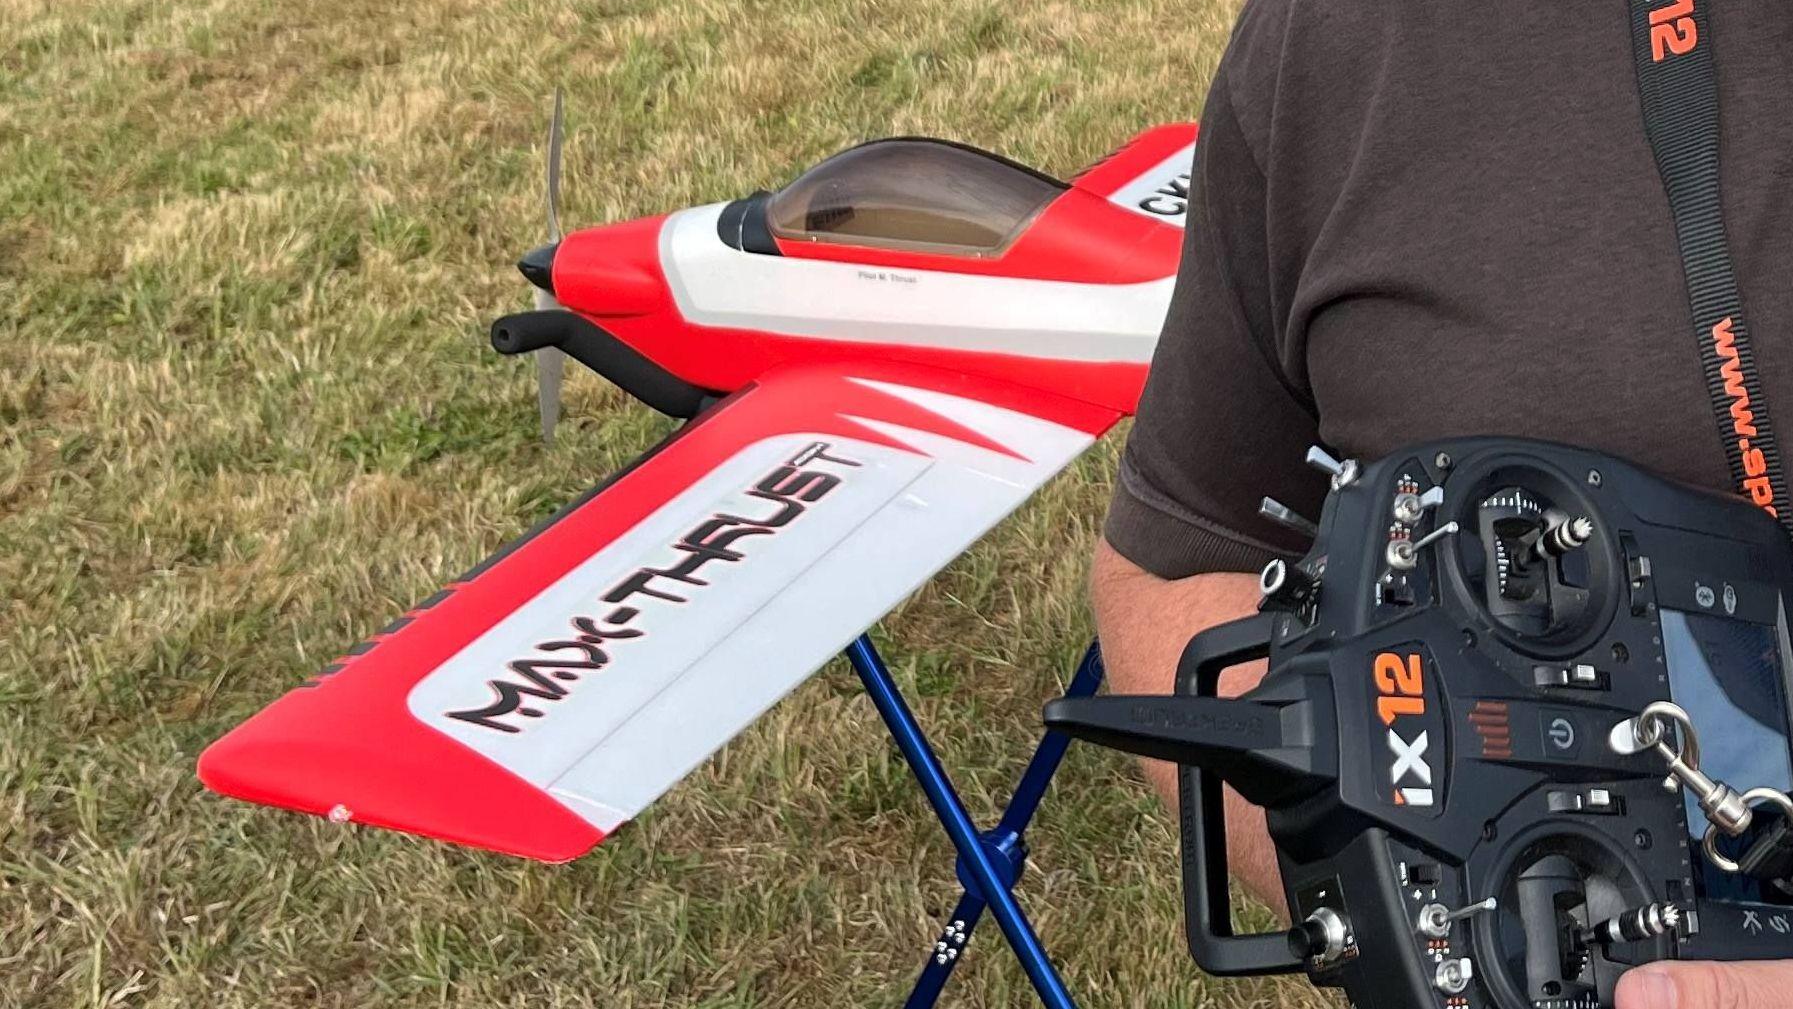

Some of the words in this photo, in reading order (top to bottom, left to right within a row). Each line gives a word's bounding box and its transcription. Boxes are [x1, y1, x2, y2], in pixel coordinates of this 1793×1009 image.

[1712, 316, 1778, 518] www.sp
[444, 441, 864, 734] MAX-THRUST
[1374, 652, 1434, 806] iX12
